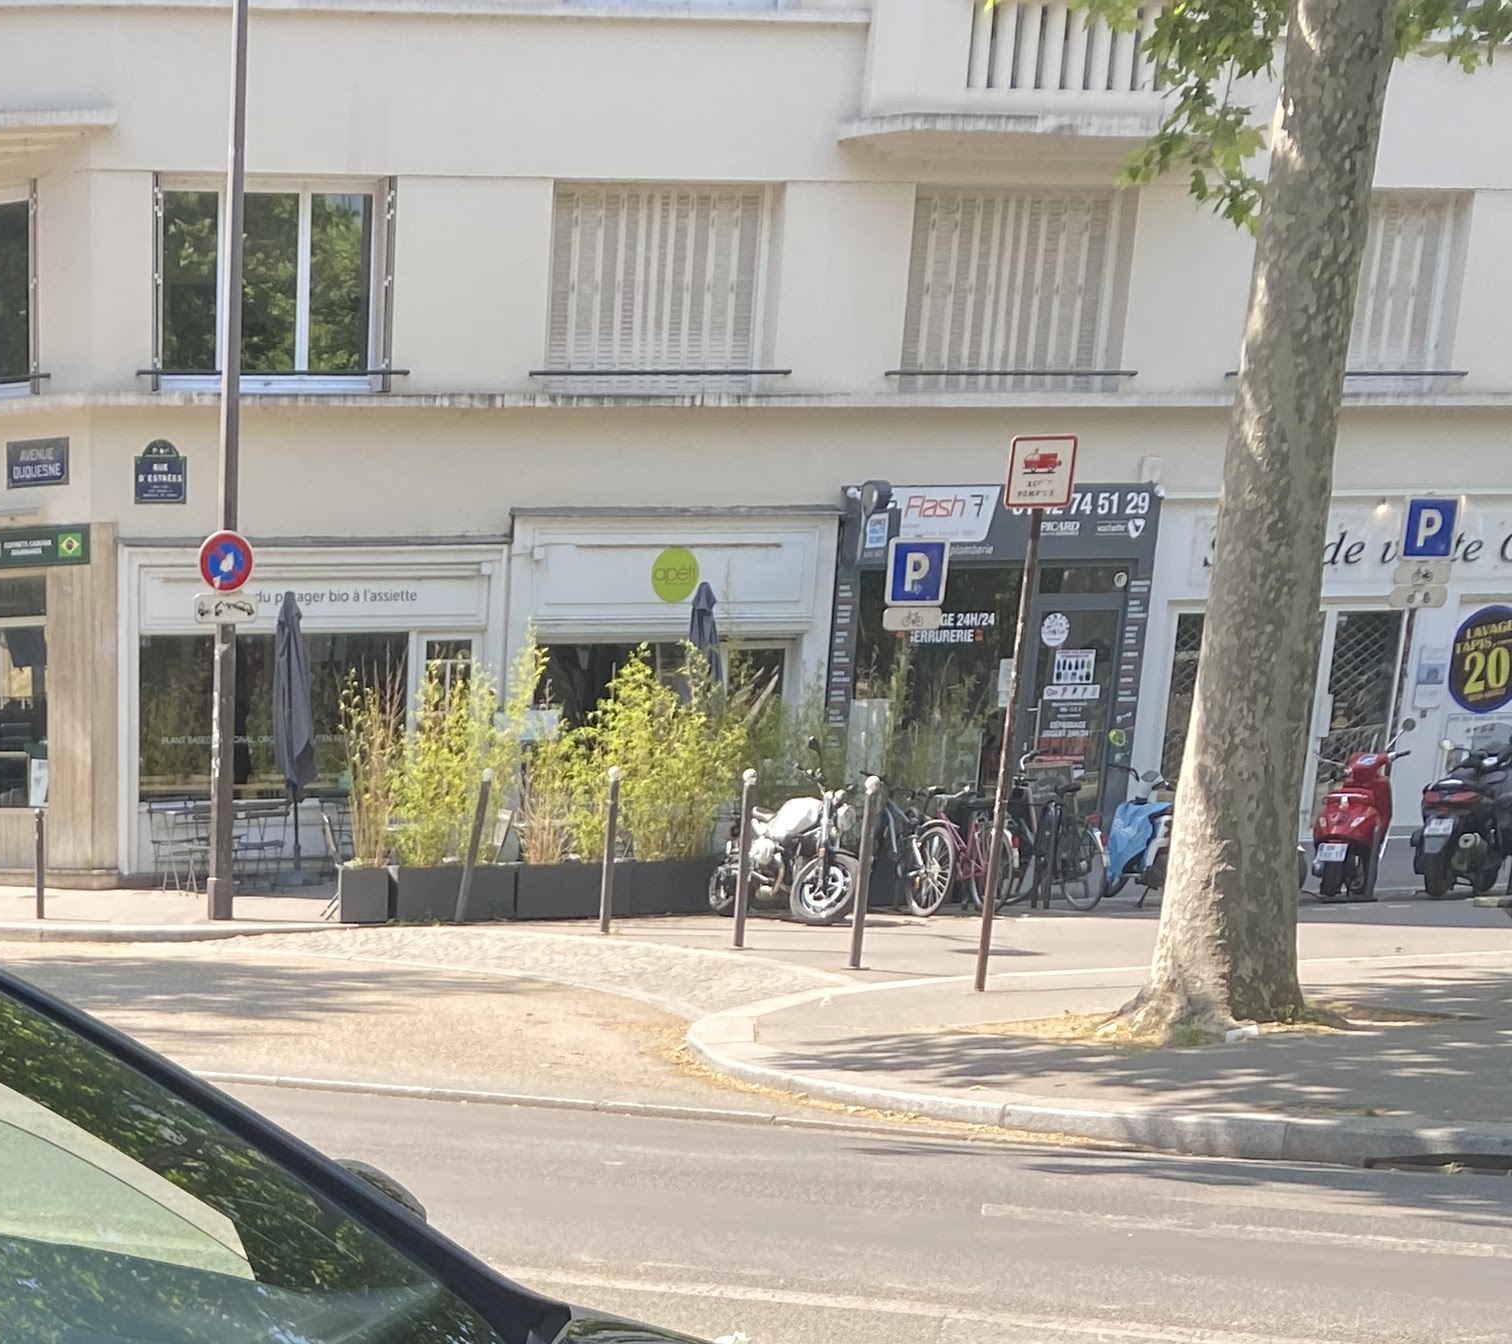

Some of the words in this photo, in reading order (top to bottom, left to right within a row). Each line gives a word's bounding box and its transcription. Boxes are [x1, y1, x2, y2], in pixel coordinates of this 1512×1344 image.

[19, 447, 55, 462] AVENUE
[12, 462, 62, 479] DUQUESNE
[152, 463, 169, 472] RUE
[138, 472, 183, 483] D'ESTRÉES
[904, 494, 966, 517] Flash
[1070, 492, 1093, 515] 74
[1097, 491, 1118, 514] 51
[1125, 491, 1150, 515] 29
[1040, 521, 1080, 532] PICARD
[1416, 508, 1444, 548] P
[1322, 530, 1366, 565] de
[904, 551, 930, 592] P
[256, 590, 271, 603] du
[275, 591, 326, 607] pager
[329, 589, 349, 603] bio
[352, 590, 360, 602] à
[364, 588, 418, 602] l'assiette
[956, 612, 995, 627] 24H/24
[1463, 646, 1510, 695] 20
